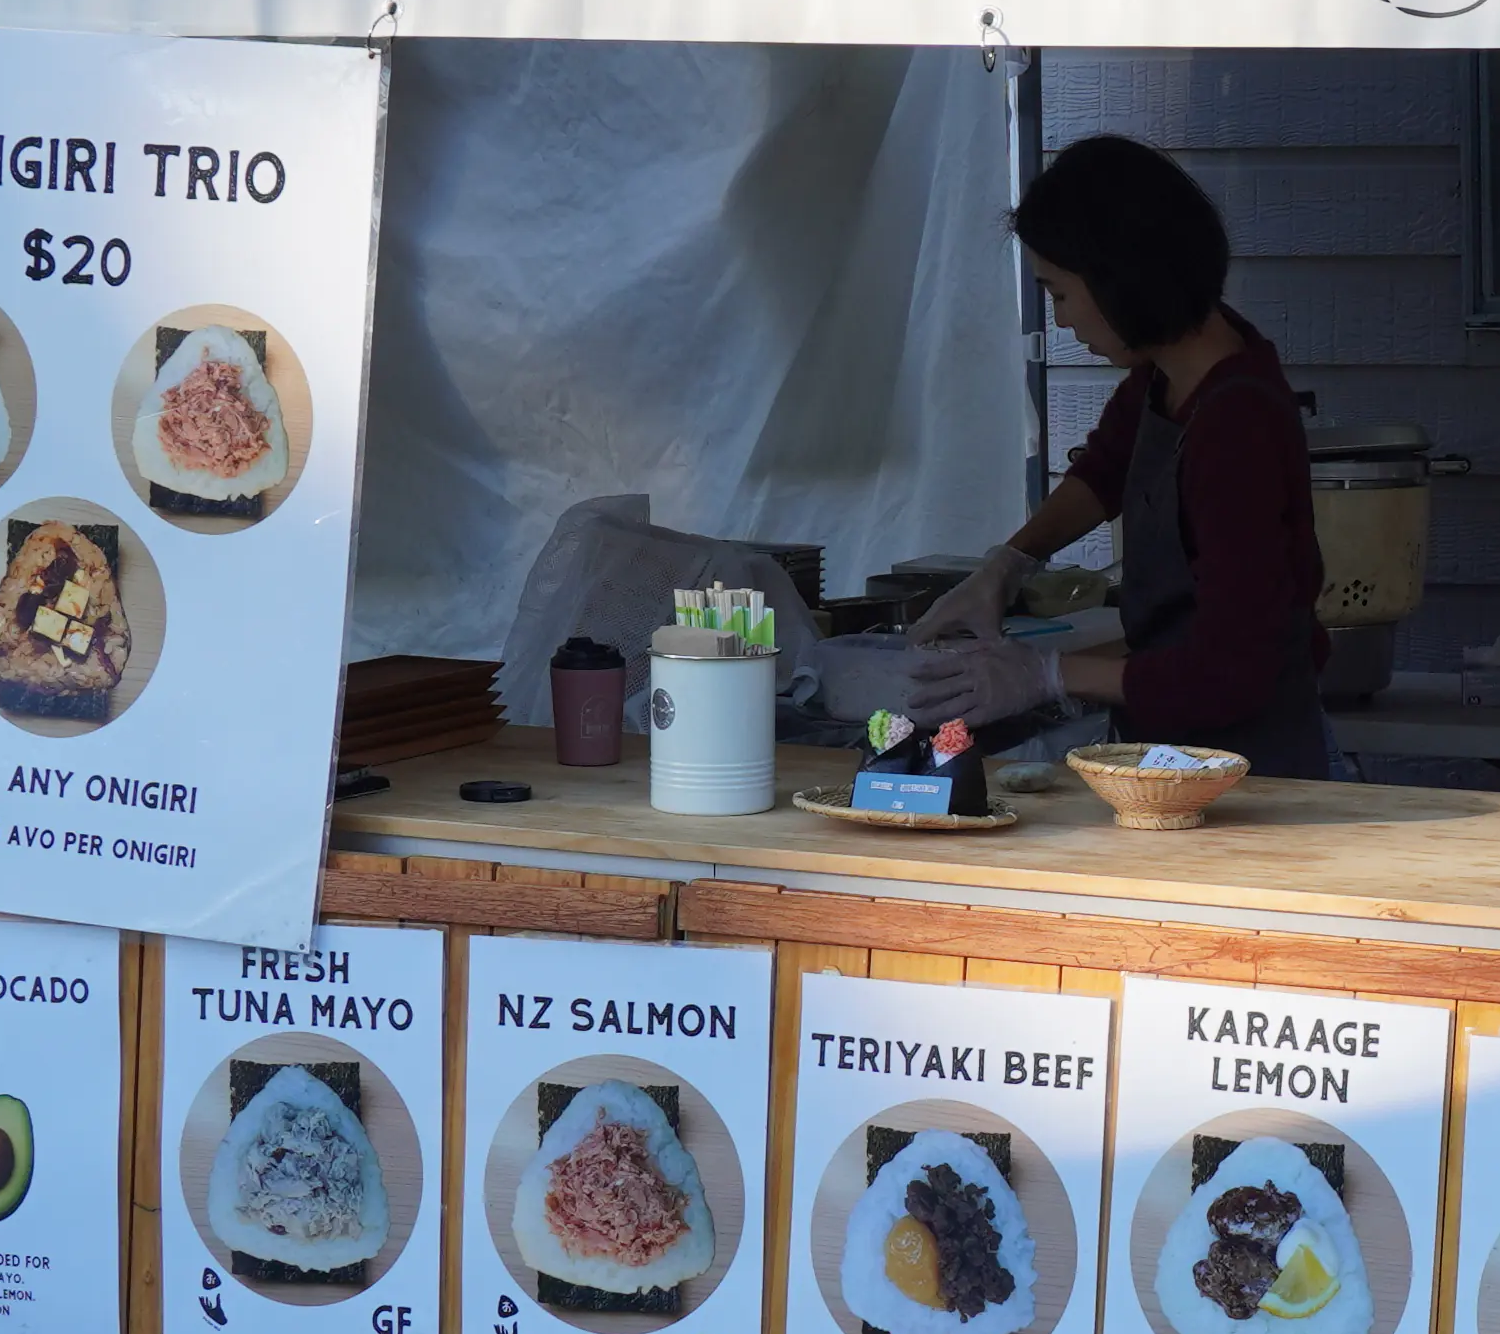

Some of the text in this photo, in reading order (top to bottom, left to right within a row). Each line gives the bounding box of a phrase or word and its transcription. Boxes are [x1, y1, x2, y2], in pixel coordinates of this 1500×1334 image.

[143, 143, 287, 204] TRIO
[21, 227, 132, 288] $20
[7, 763, 73, 799] ANY
[84, 773, 198, 815] ONIGIRI
[7, 823, 57, 851] AVO
[63, 830, 104, 860] PER
[111, 834, 197, 870] ONIGIRI
[240, 946, 351, 985] FRESH
[192, 987, 414, 1032] TUNA MAYO
[499, 993, 736, 1040] NZ SALMON
[1186, 1006, 1380, 1059] KARAAGE
[811, 1032, 1094, 1091] TERIYAKI BEEF
[1211, 1056, 1350, 1104] LEMON
[25, 1255, 51, 1270] FOR
